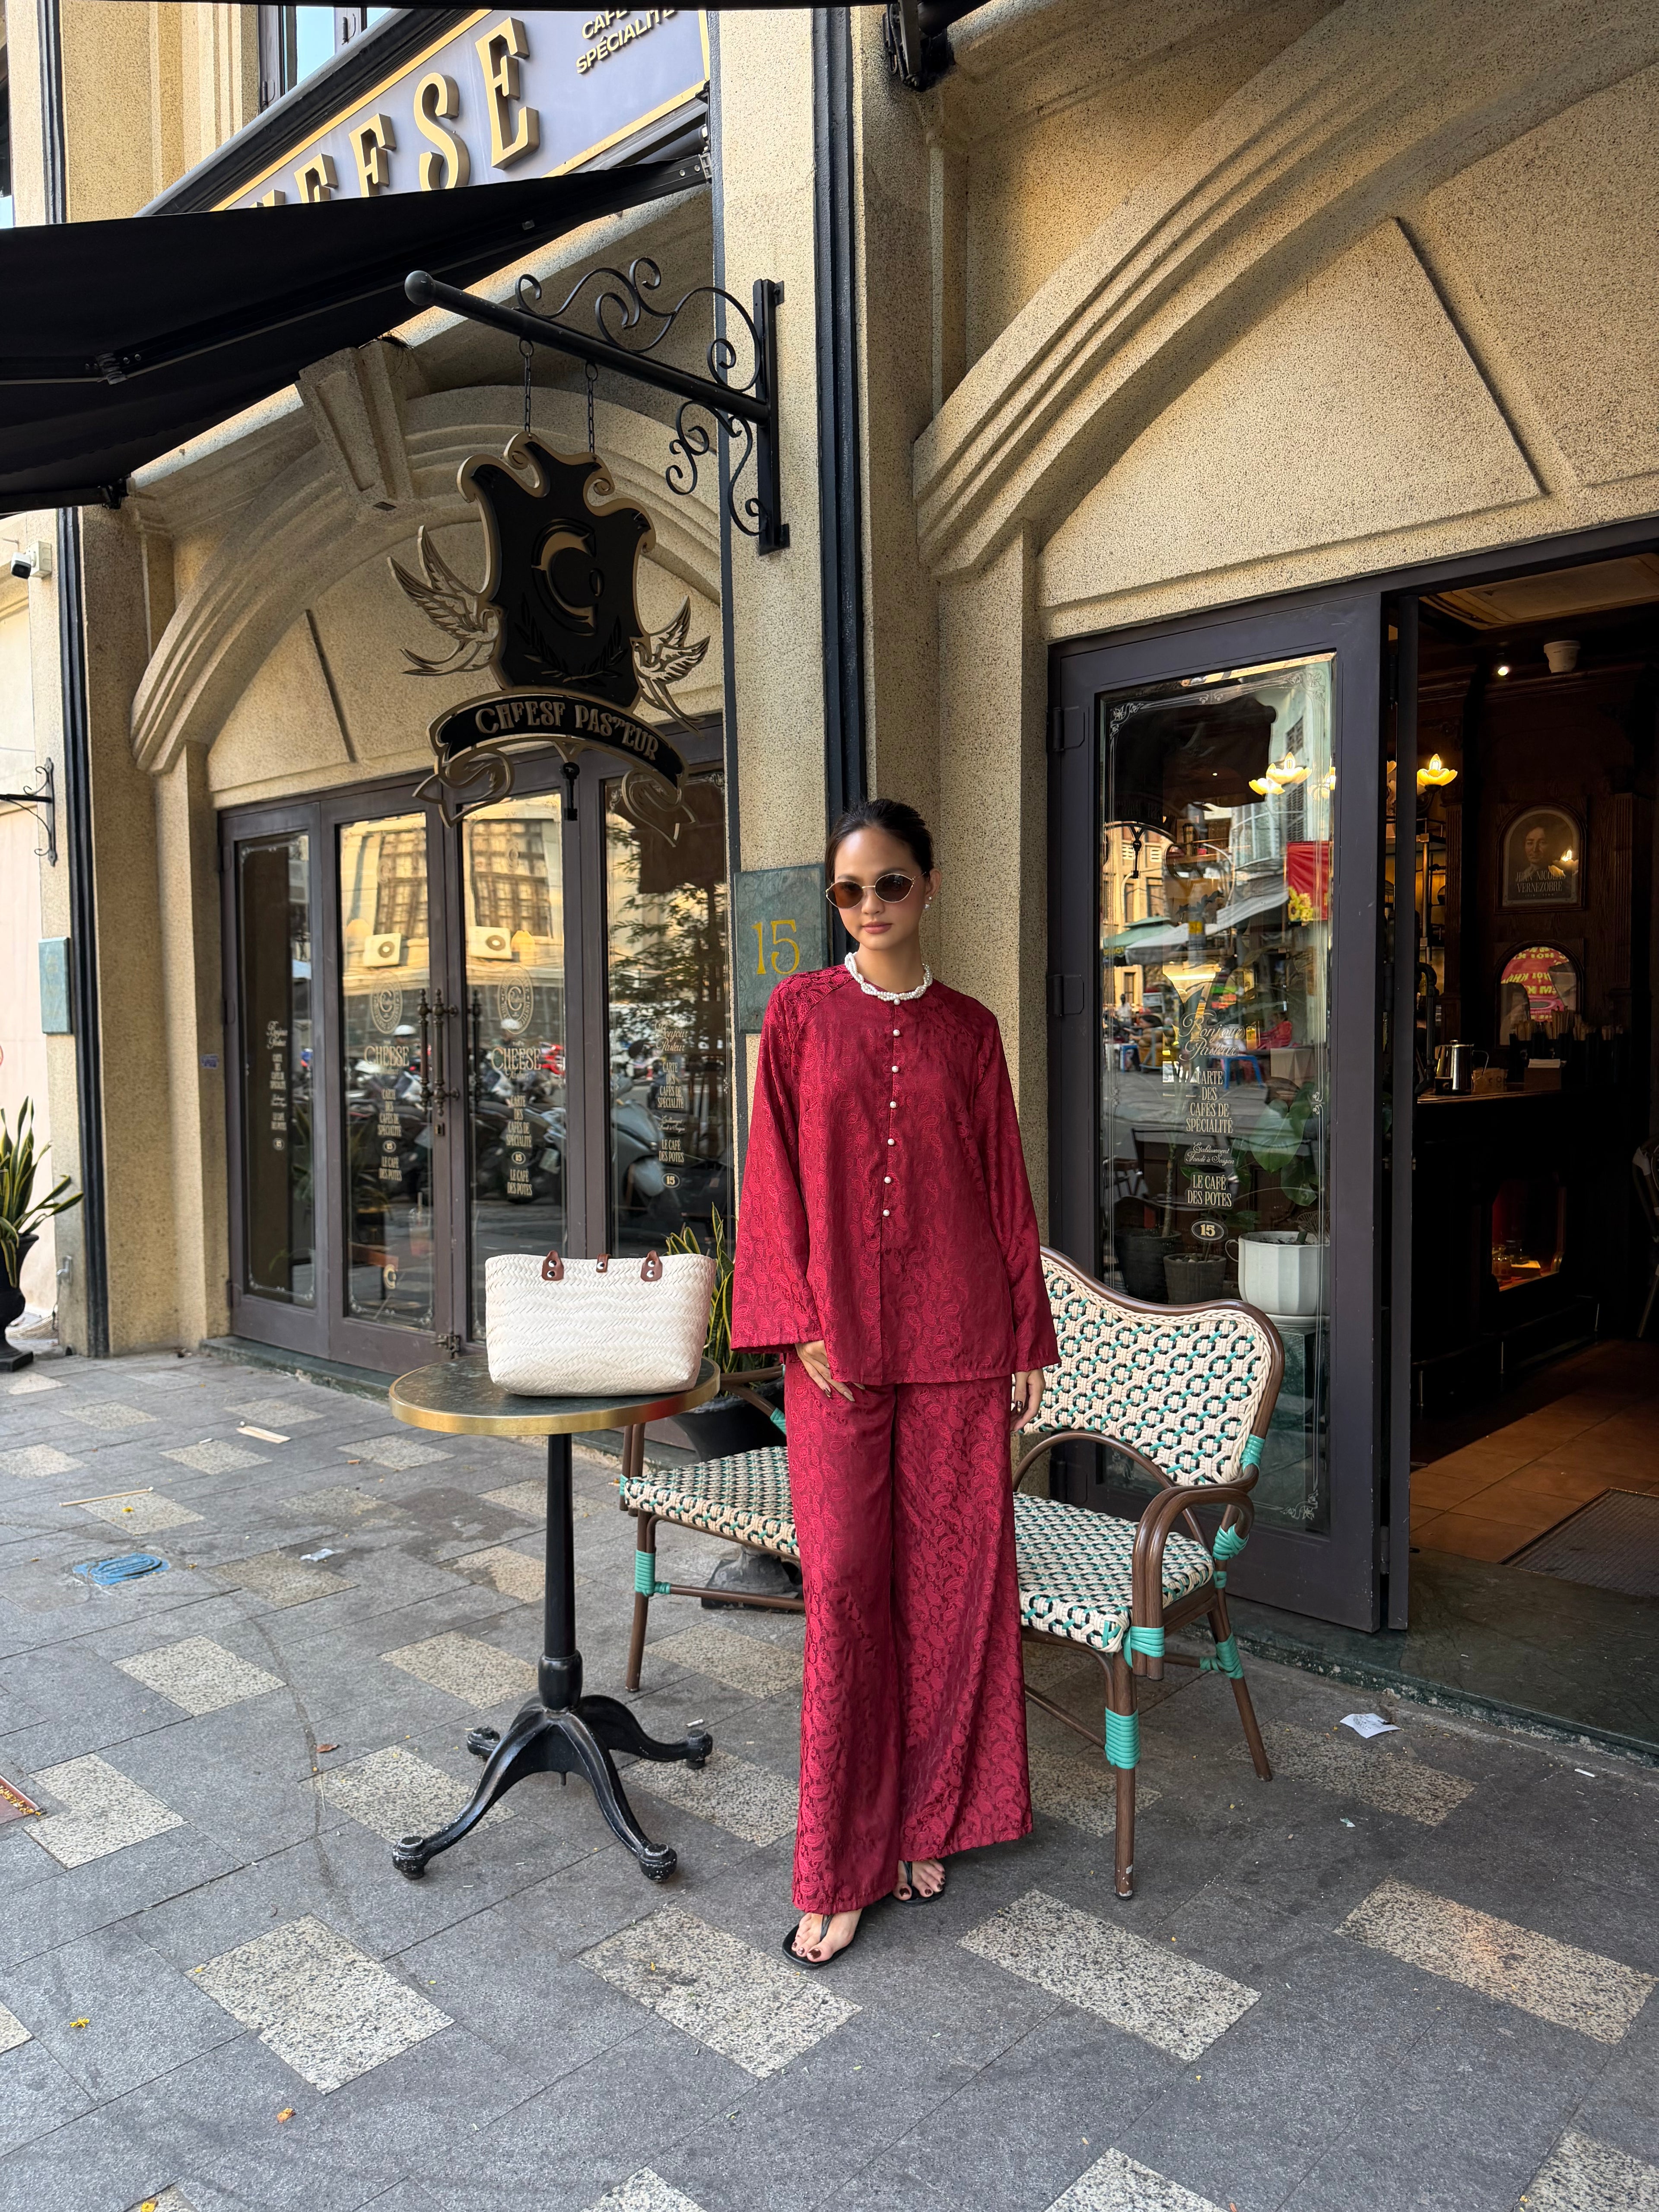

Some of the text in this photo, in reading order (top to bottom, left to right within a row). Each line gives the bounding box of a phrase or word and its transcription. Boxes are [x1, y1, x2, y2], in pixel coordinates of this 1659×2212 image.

[575, 705, 659, 760] PASTEUR
[1517, 881, 1563, 893] VERNEZOBRE
[751, 919, 800, 975] 15
[1179, 1013, 1243, 1043] Bonjour
[364, 1046, 410, 1067] CHEESE
[1179, 1037, 1236, 1061] Pasteur
[491, 1048, 541, 1071] CHEESE
[662, 1062, 678, 1072] CARTE
[1196, 1071, 1223, 1085] CARTE
[1202, 1087, 1217, 1100] DES
[1190, 1101, 1229, 1117] CAFÉS DE
[1186, 1116, 1233, 1133] SPÉCIALITÉ
[661, 1139, 681, 1150] LE CAFÉ
[669, 1151, 684, 1163] POTES
[1211, 1153, 1234, 1166] Saigon
[666, 1175, 676, 1185] 15
[1193, 1175, 1226, 1190] LE CAFÉ
[1188, 1190, 1232, 1207] DES POTES
[1200, 1224, 1215, 1236] 15
